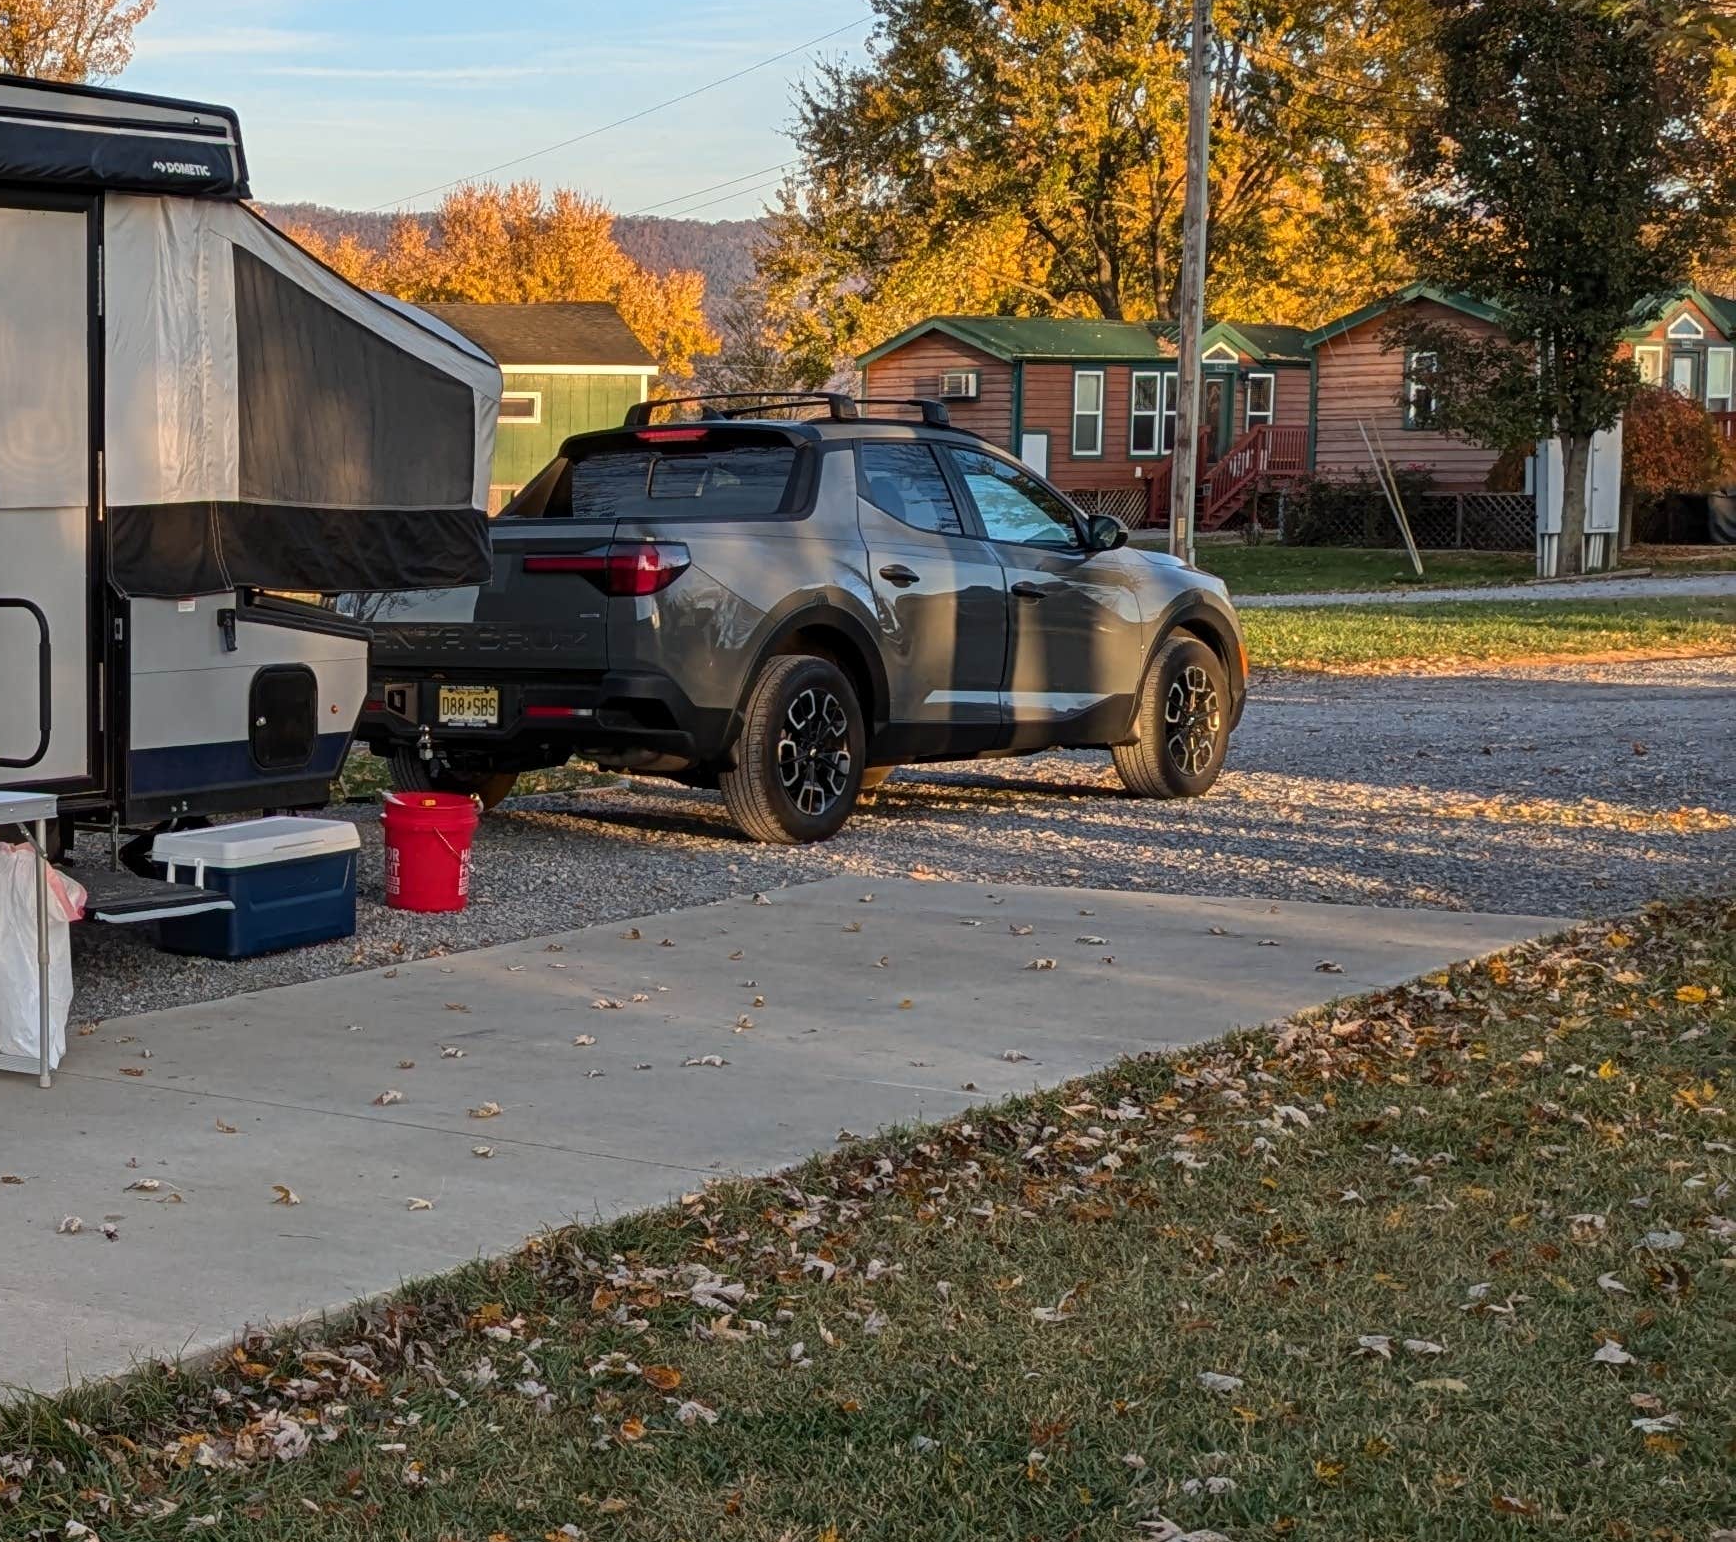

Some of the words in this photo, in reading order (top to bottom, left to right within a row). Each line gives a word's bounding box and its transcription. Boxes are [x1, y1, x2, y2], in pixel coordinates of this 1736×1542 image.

[166, 162, 211, 177] DOMETIC
[442, 696, 465, 716] D88
[473, 697, 496, 717] SBS
